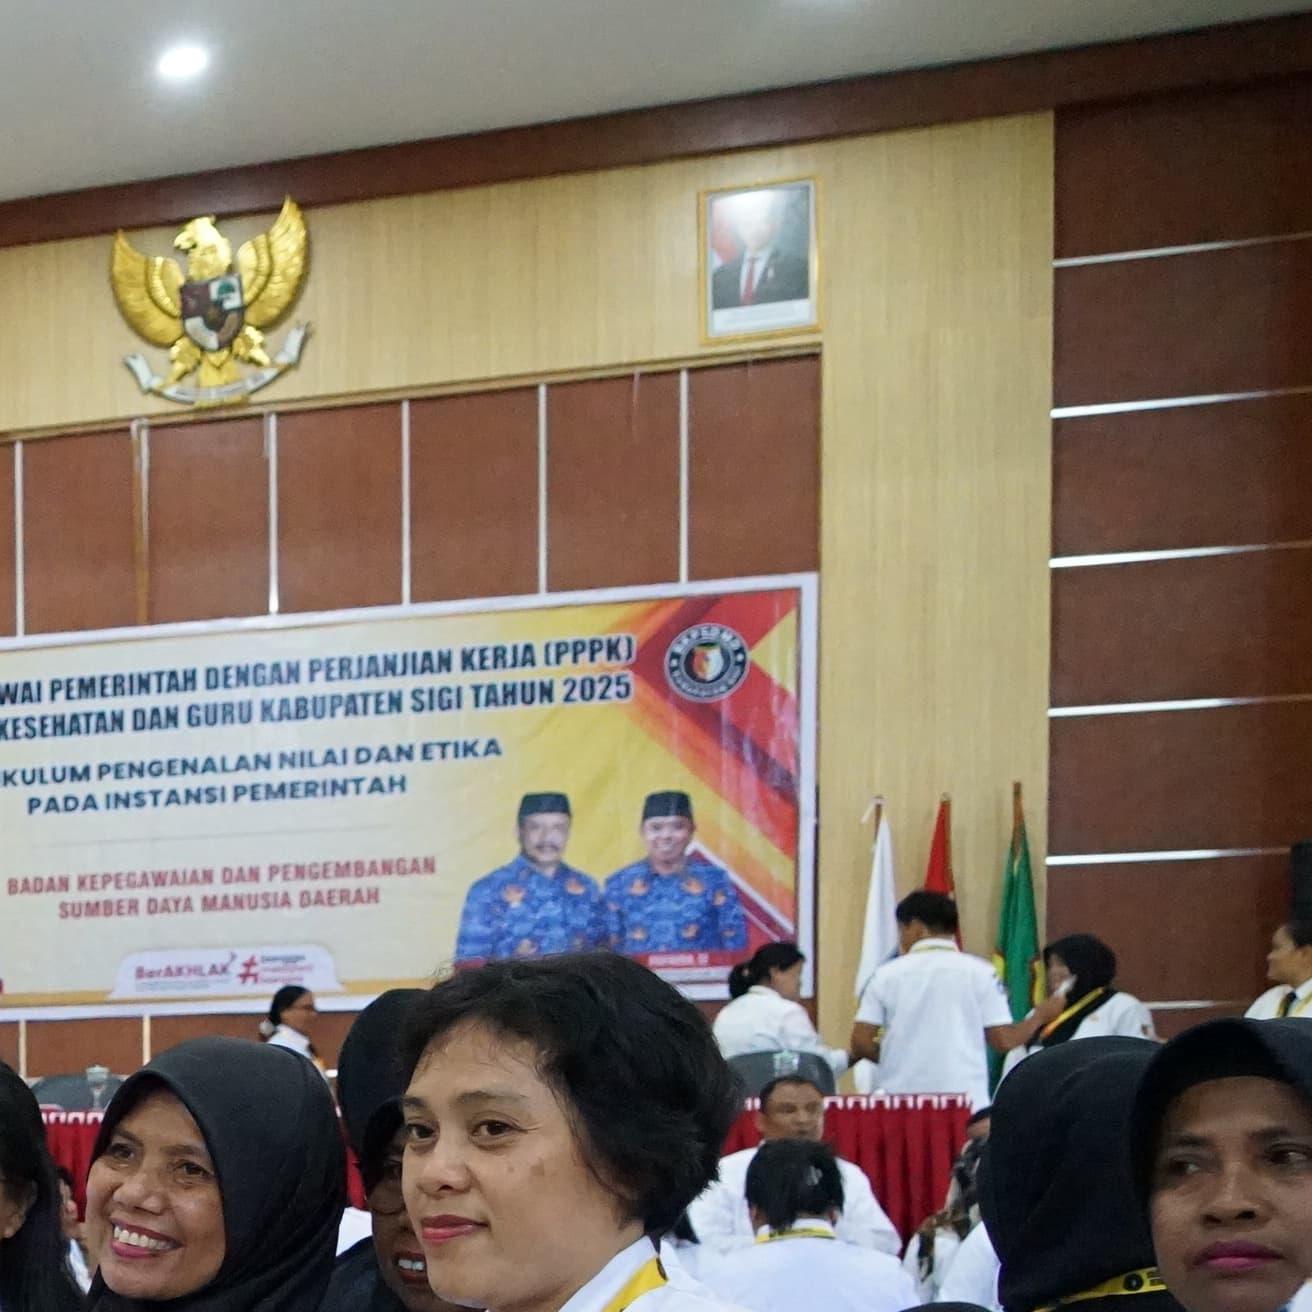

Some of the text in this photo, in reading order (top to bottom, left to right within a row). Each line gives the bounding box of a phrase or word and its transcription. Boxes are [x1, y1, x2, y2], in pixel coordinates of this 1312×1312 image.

[49, 667, 197, 703] PEMERINTAH
[204, 662, 301, 691] DENGAN
[308, 647, 452, 683] PERJANJIAN
[460, 642, 537, 672] KERJA
[543, 635, 634, 666] (PPPK)
[132, 705, 178, 732] DAN
[187, 697, 253, 727] GURU
[260, 689, 403, 724] KABUPATEN
[410, 685, 463, 713] SIGI
[470, 679, 555, 709] TAHUN
[562, 673, 632, 702] 2025
[97, 751, 272, 782] PENGENALAN
[278, 747, 348, 770] NILAI
[354, 742, 415, 765] DAN
[421, 737, 503, 762] ETIKA
[27, 774, 407, 815] PADA INSTANSI PEMERINTAH
[7, 856, 437, 897] BADAN KEPEGAWAIAN DAN PENGEMBANGAN
[58, 886, 381, 920] SUMBER DAYA MANUSIA DAERAH
[135, 962, 231, 980] BerAKHLAK
